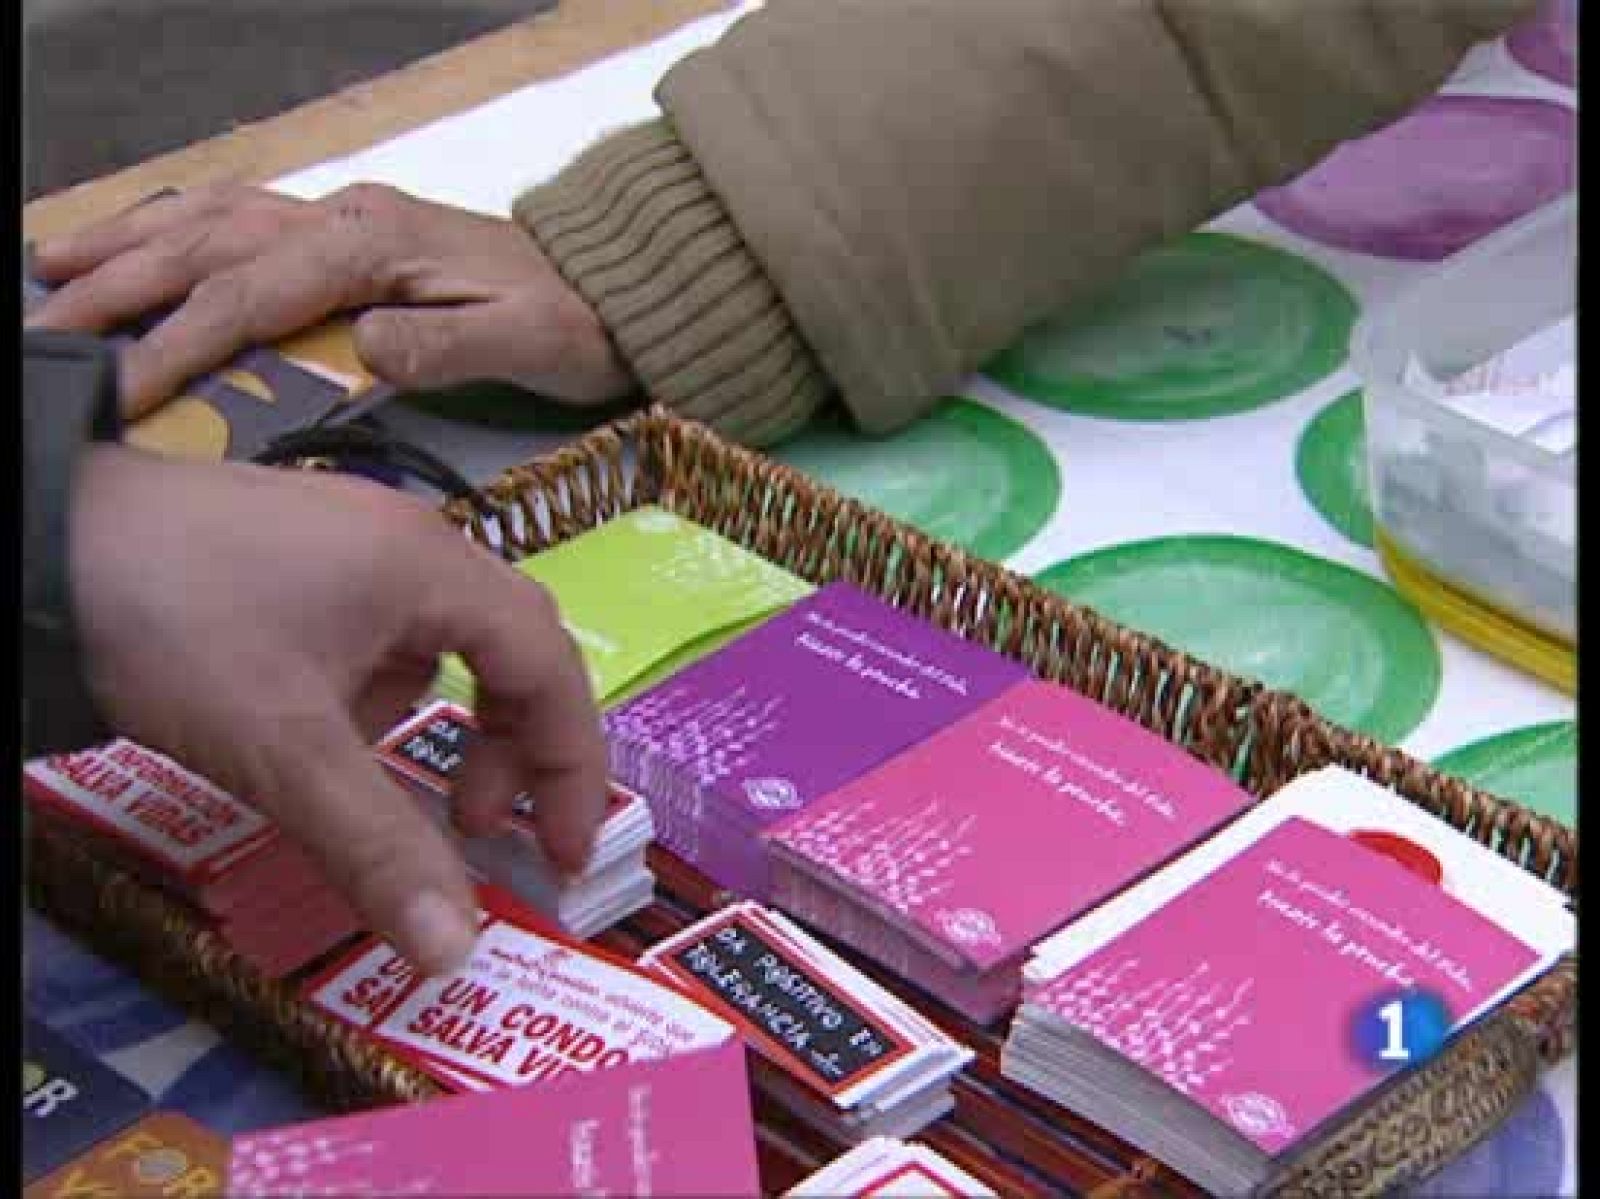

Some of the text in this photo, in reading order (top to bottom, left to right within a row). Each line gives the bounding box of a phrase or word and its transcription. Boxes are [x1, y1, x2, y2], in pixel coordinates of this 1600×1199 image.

[407, 1006, 515, 1064] SALVA
[438, 976, 500, 1017] UN
[500, 1003, 630, 1071] CONDO
